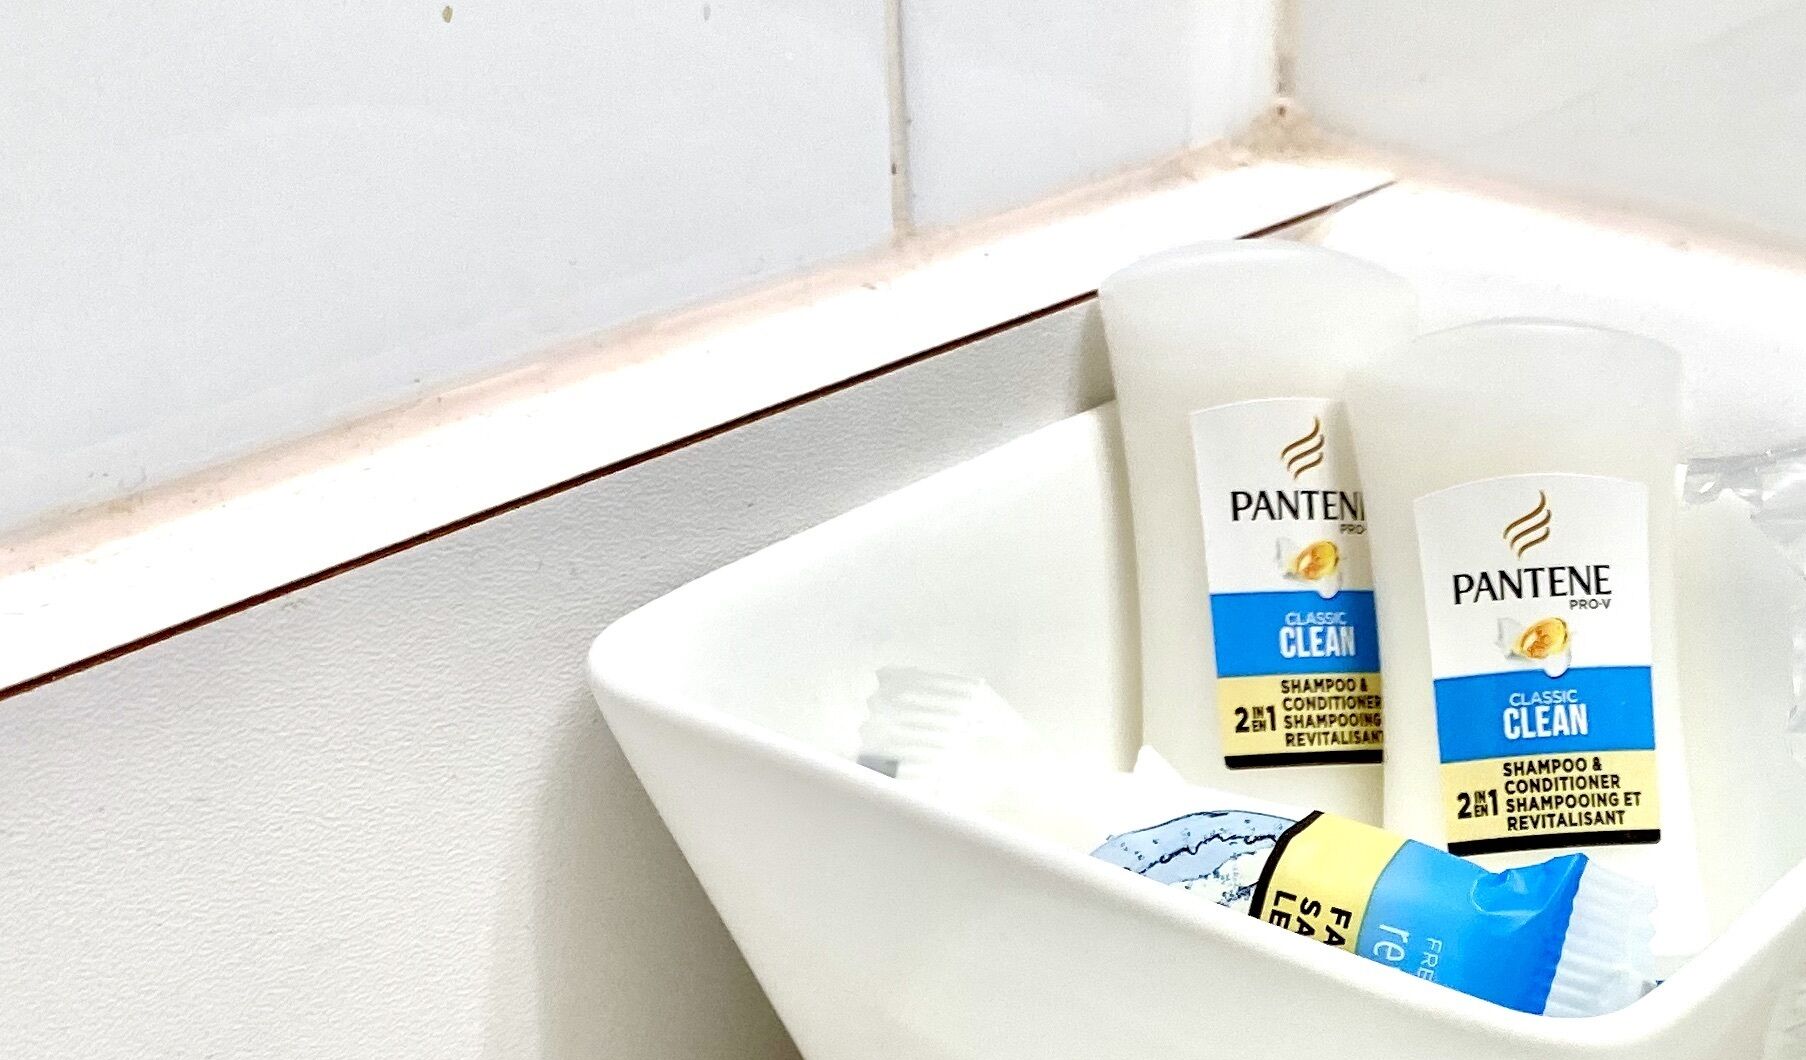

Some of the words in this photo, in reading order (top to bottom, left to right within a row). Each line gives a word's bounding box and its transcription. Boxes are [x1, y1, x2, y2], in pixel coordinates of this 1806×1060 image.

[1340, 523, 1367, 535] PRO-
[1453, 565, 1612, 604] PANTENE
[1569, 599, 1611, 610] PRO-V
[1285, 611, 1347, 626] CLASSIC
[1280, 626, 1356, 658] CLEAN
[1281, 678, 1356, 694] SHAMPOO
[1360, 677, 1368, 692] &
[1283, 695, 1381, 711] CONDITIONER
[1510, 689, 1578, 707] CLASSIC
[1235, 706, 1250, 733] 2
[1266, 705, 1277, 731] 1
[1284, 712, 1381, 729] SHAMPOOING
[1503, 703, 1589, 740] CLEAN
[1285, 730, 1384, 747] REVITALISANT
[1503, 757, 1588, 777] SHAMPOO
[1592, 757, 1602, 771] &
[1505, 774, 1621, 795] CONDITIONER
[1457, 792, 1473, 820] 2
[1475, 790, 1487, 804] IN
[1488, 789, 1499, 816] 1
[1506, 794, 1619, 813] SHAMPOOING
[1624, 791, 1641, 806] ET
[1475, 804, 1488, 817] EN
[1507, 810, 1626, 832] REVITALISANT
